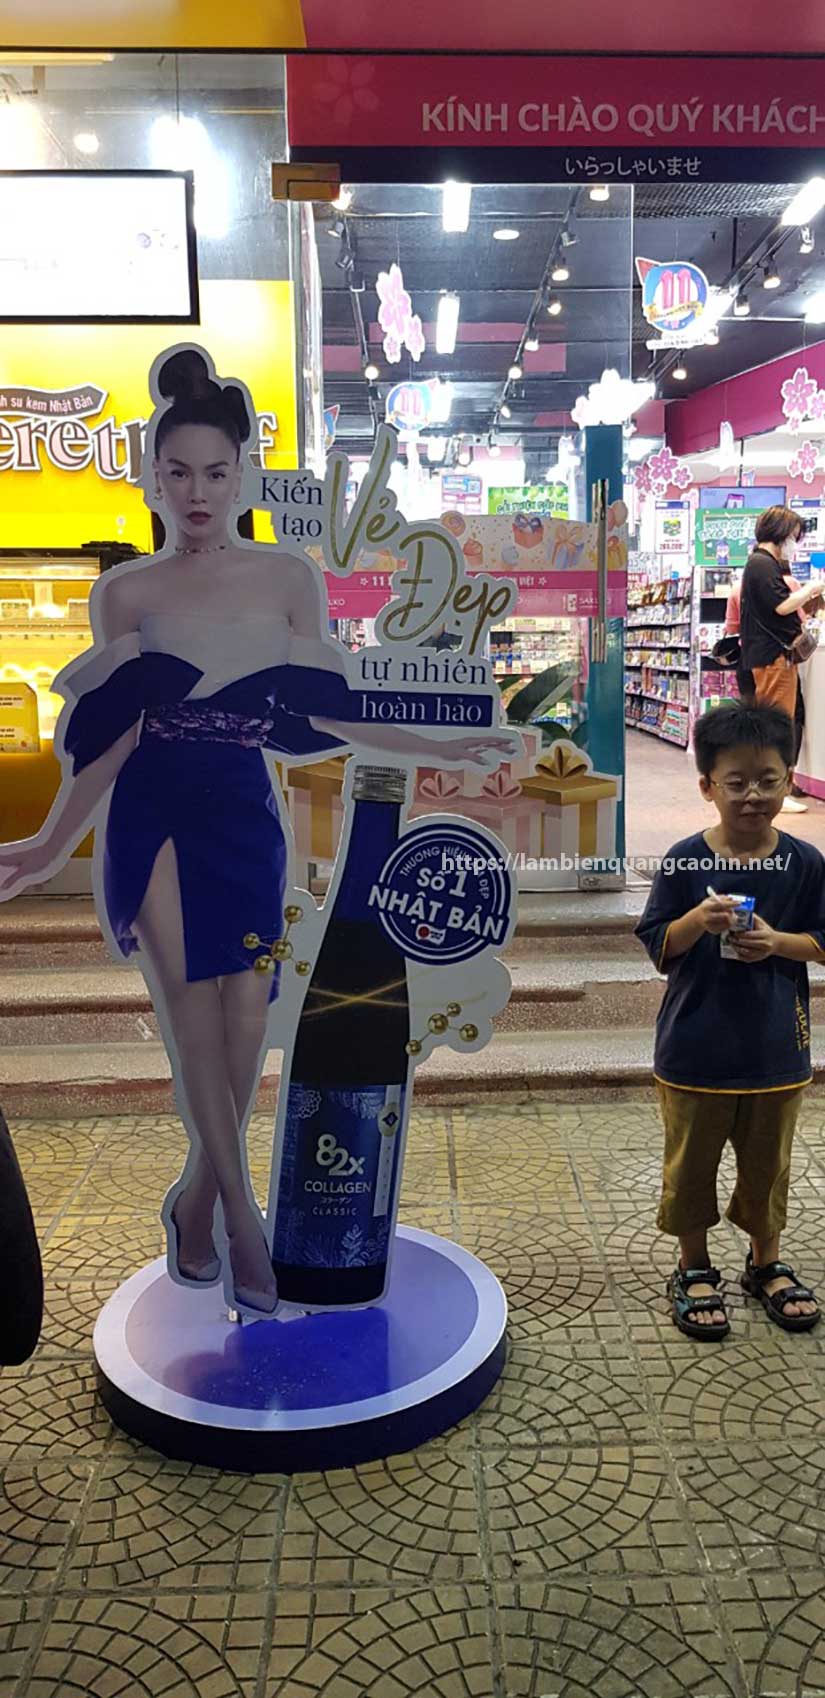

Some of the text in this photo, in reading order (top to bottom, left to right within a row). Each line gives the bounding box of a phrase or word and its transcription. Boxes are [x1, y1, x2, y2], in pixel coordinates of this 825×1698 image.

[421, 96, 825, 136] KÍNH CHÀO QUÝ KHÁCH
[565, 157, 701, 176] いらっしゃいませ
[11, 397, 23, 408] su
[26, 396, 47, 411] kem
[50, 399, 73, 415] Nhật
[73, 394, 93, 410] Bản
[261, 476, 323, 505] Kiến
[330, 437, 399, 568] Vẻ
[282, 513, 322, 542] tạo
[382, 530, 511, 655] Đẹp
[361, 657, 488, 687] tự nhiên
[361, 695, 482, 723] hoàn hảo
[449, 870, 468, 898] 1
[368, 885, 503, 940] NHẬT BẢN
[304, 1180, 372, 1194] COLLAGEN
[312, 1206, 358, 1217] CLASSIC
